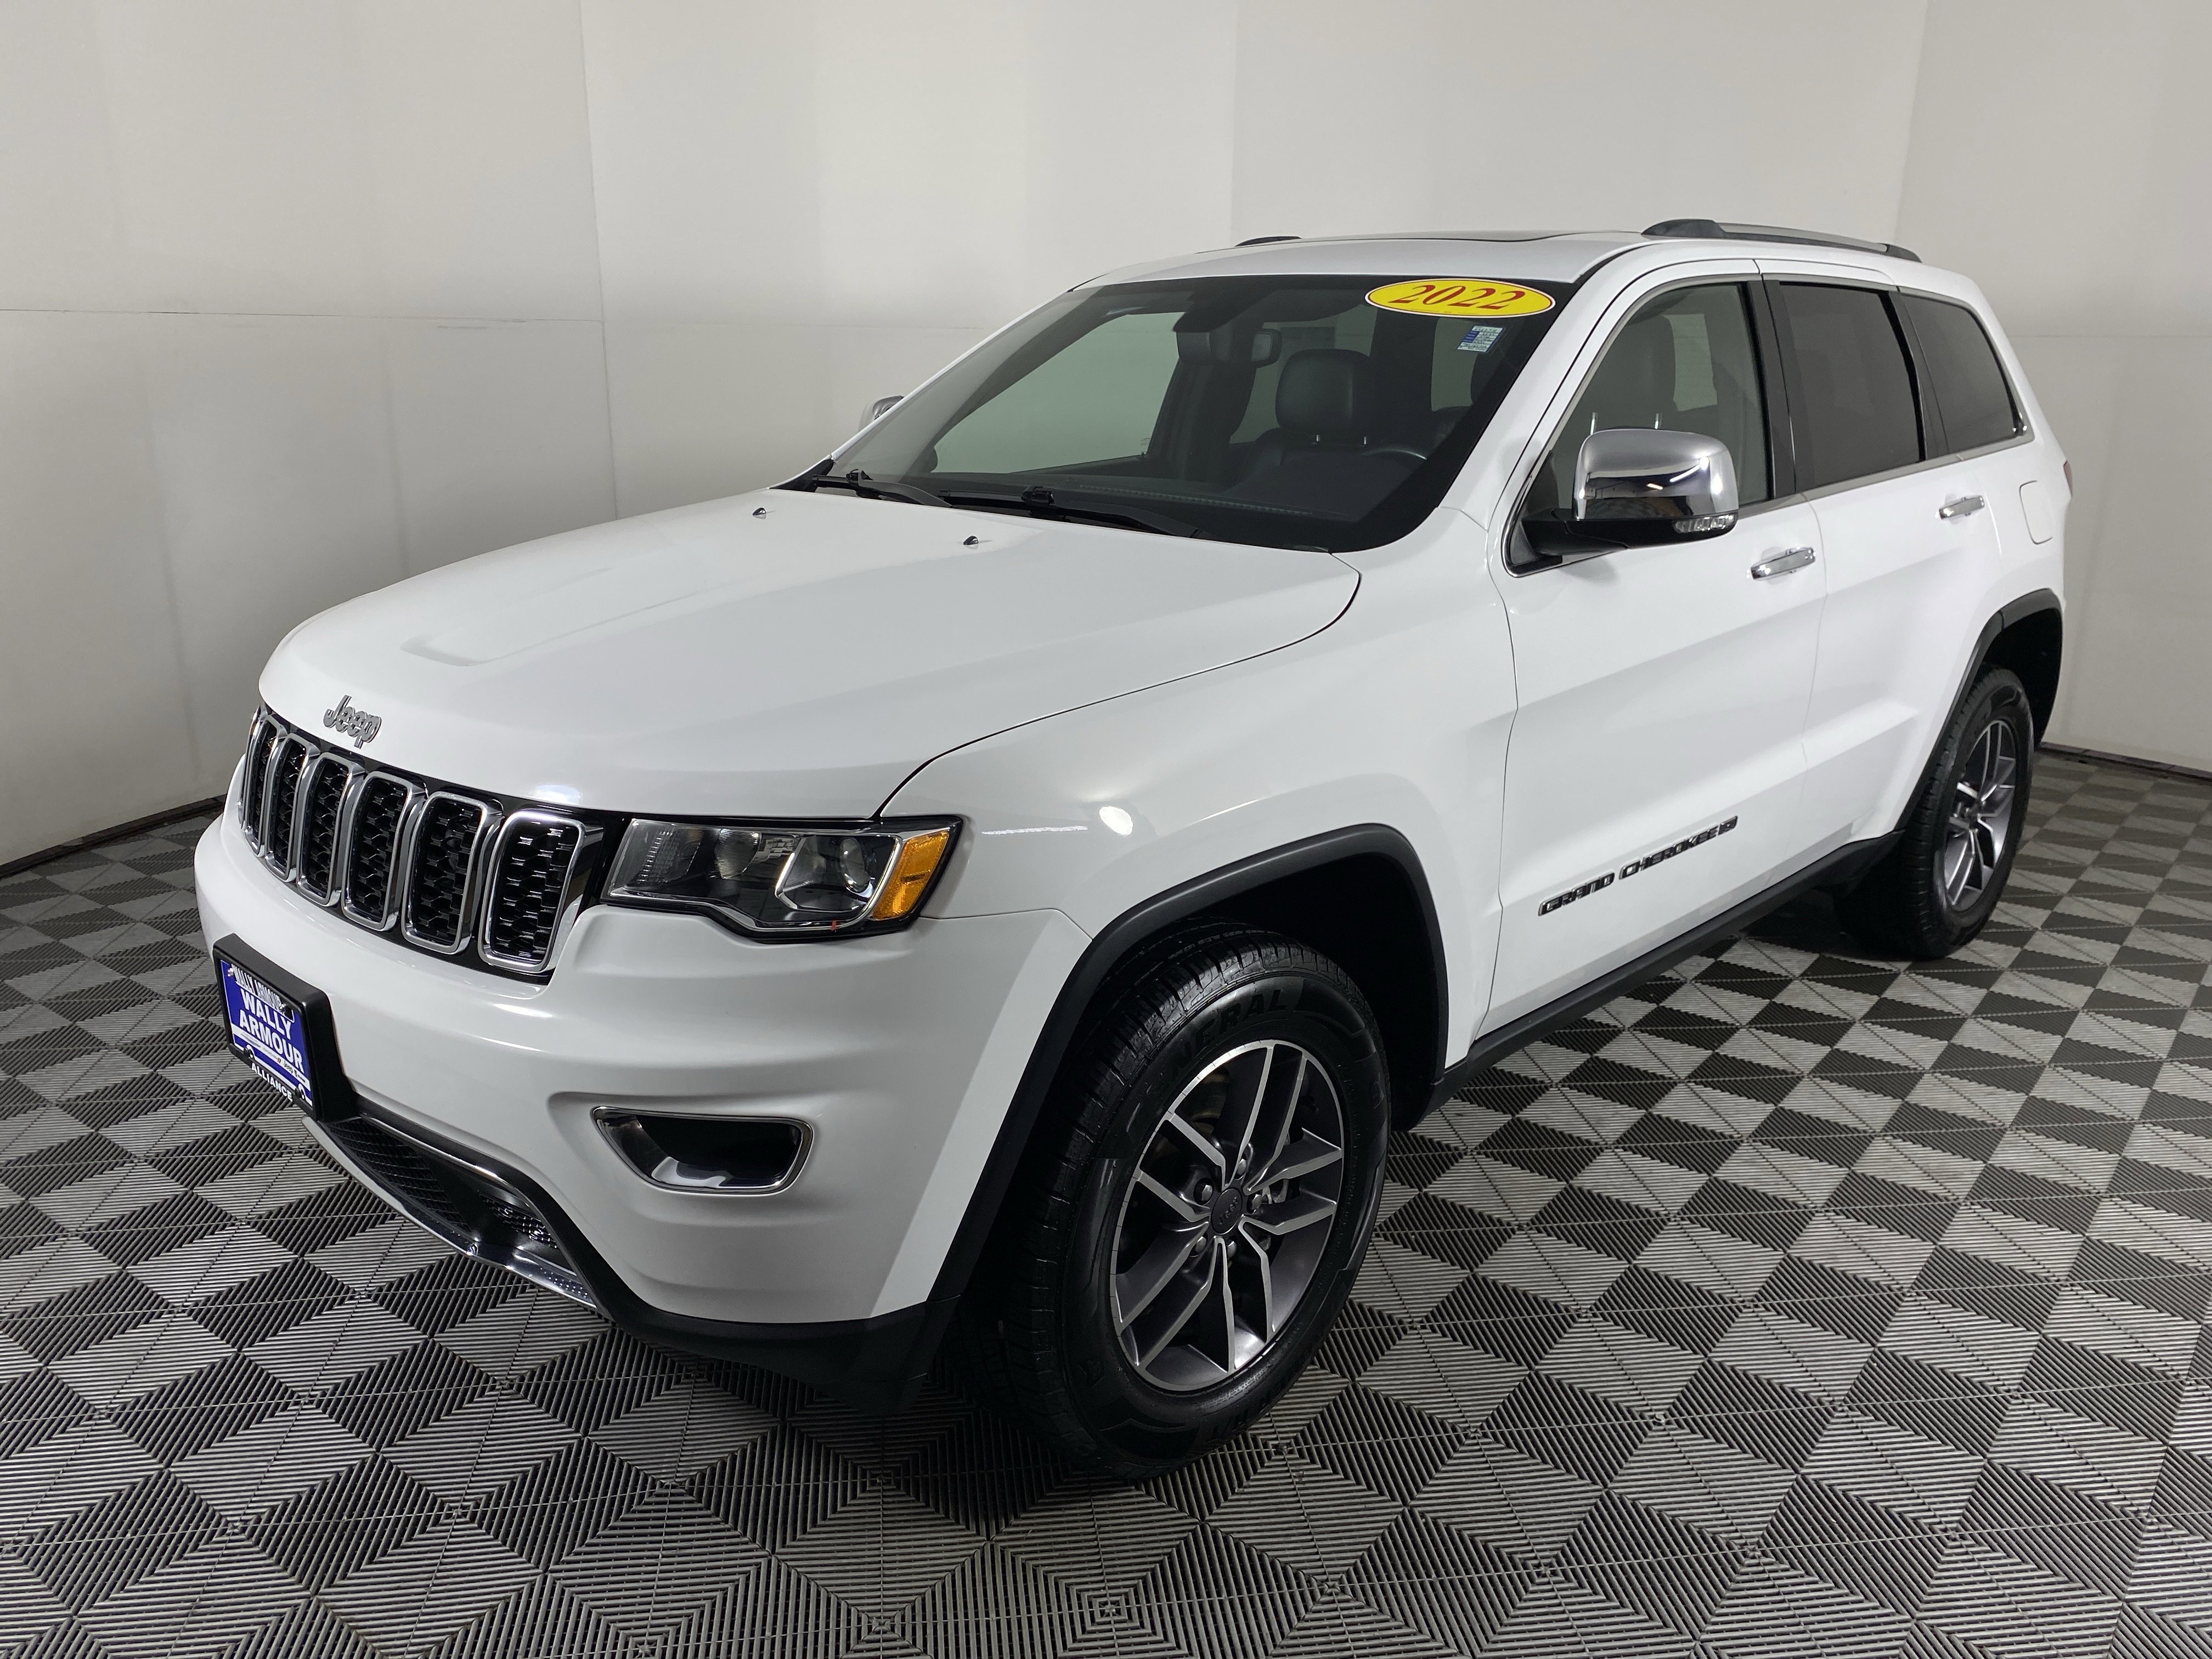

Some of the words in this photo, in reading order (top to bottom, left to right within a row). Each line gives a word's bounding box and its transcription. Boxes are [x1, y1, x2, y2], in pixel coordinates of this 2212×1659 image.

[1388, 285, 1526, 310] 2022
[323, 695, 381, 749] Jeep
[1538, 872, 1615, 916] GRAND
[1618, 825, 1718, 879] CHEROKEE
[240, 988, 292, 1040] WALLY
[239, 1009, 304, 1074] ARMOUR
[252, 1062, 293, 1102] ALLIANCE
